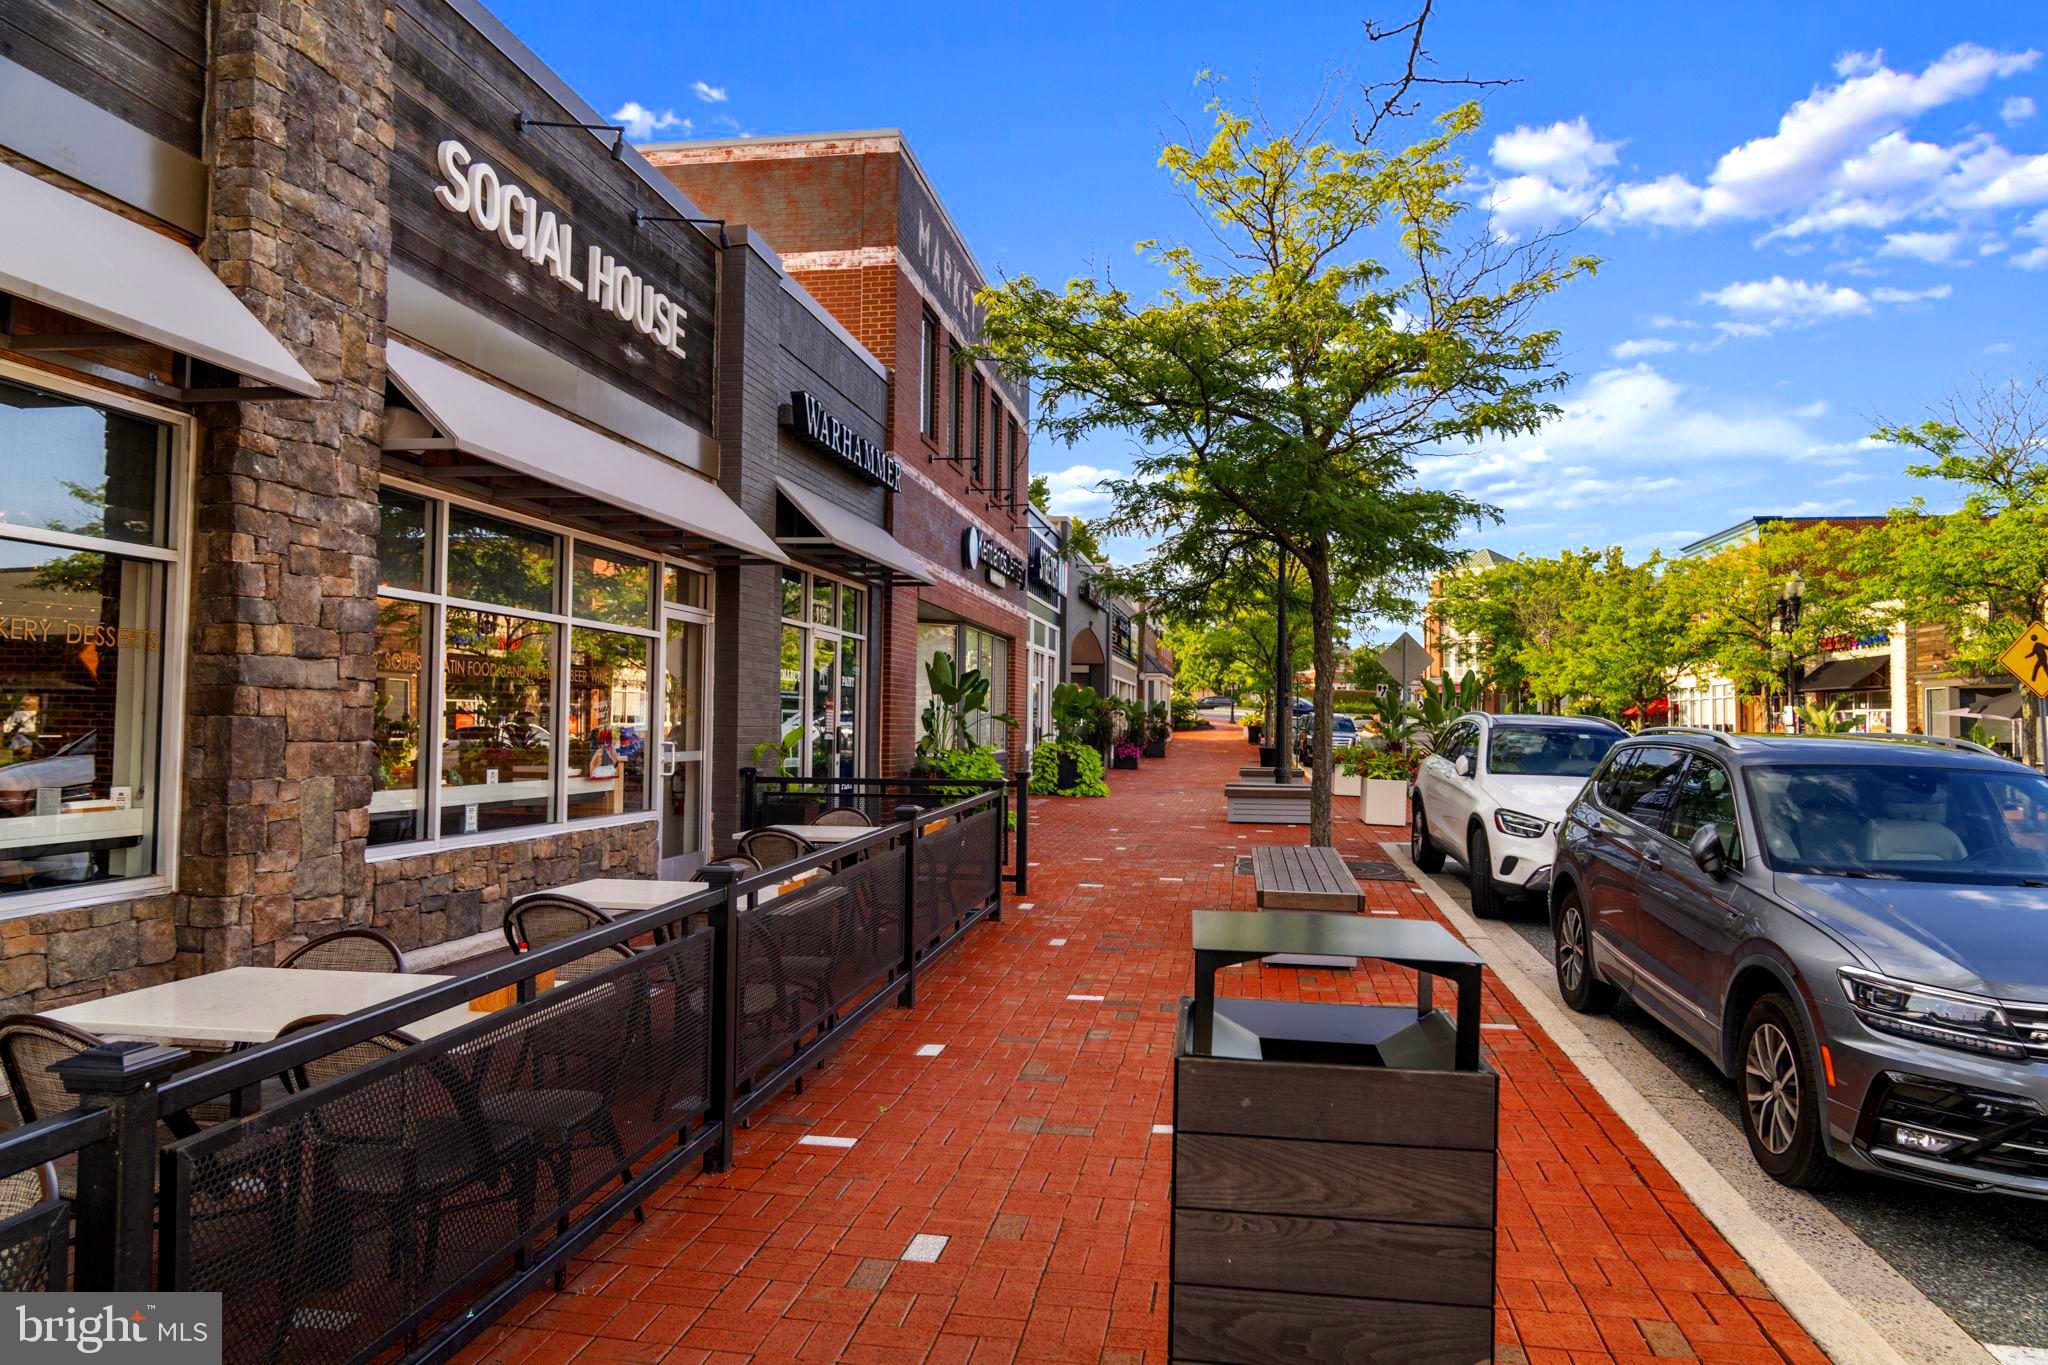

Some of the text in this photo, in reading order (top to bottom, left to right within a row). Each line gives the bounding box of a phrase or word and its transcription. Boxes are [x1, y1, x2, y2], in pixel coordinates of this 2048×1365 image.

[434, 140, 687, 359] SOCIAL HOUSE
[804, 392, 902, 493] WARHAMMER
[815, 606, 828, 624] 119
[66, 623, 158, 651] DESSERTS
[384, 653, 422, 670] SOUPS
[445, 659, 466, 676] ATIN
[467, 662, 496, 677] FOOD
[502, 664, 553, 680] SANDWICHE
[570, 669, 587, 683] BEER
[591, 670, 609, 684] WINE
[781, 669, 801, 682] OLLECT
